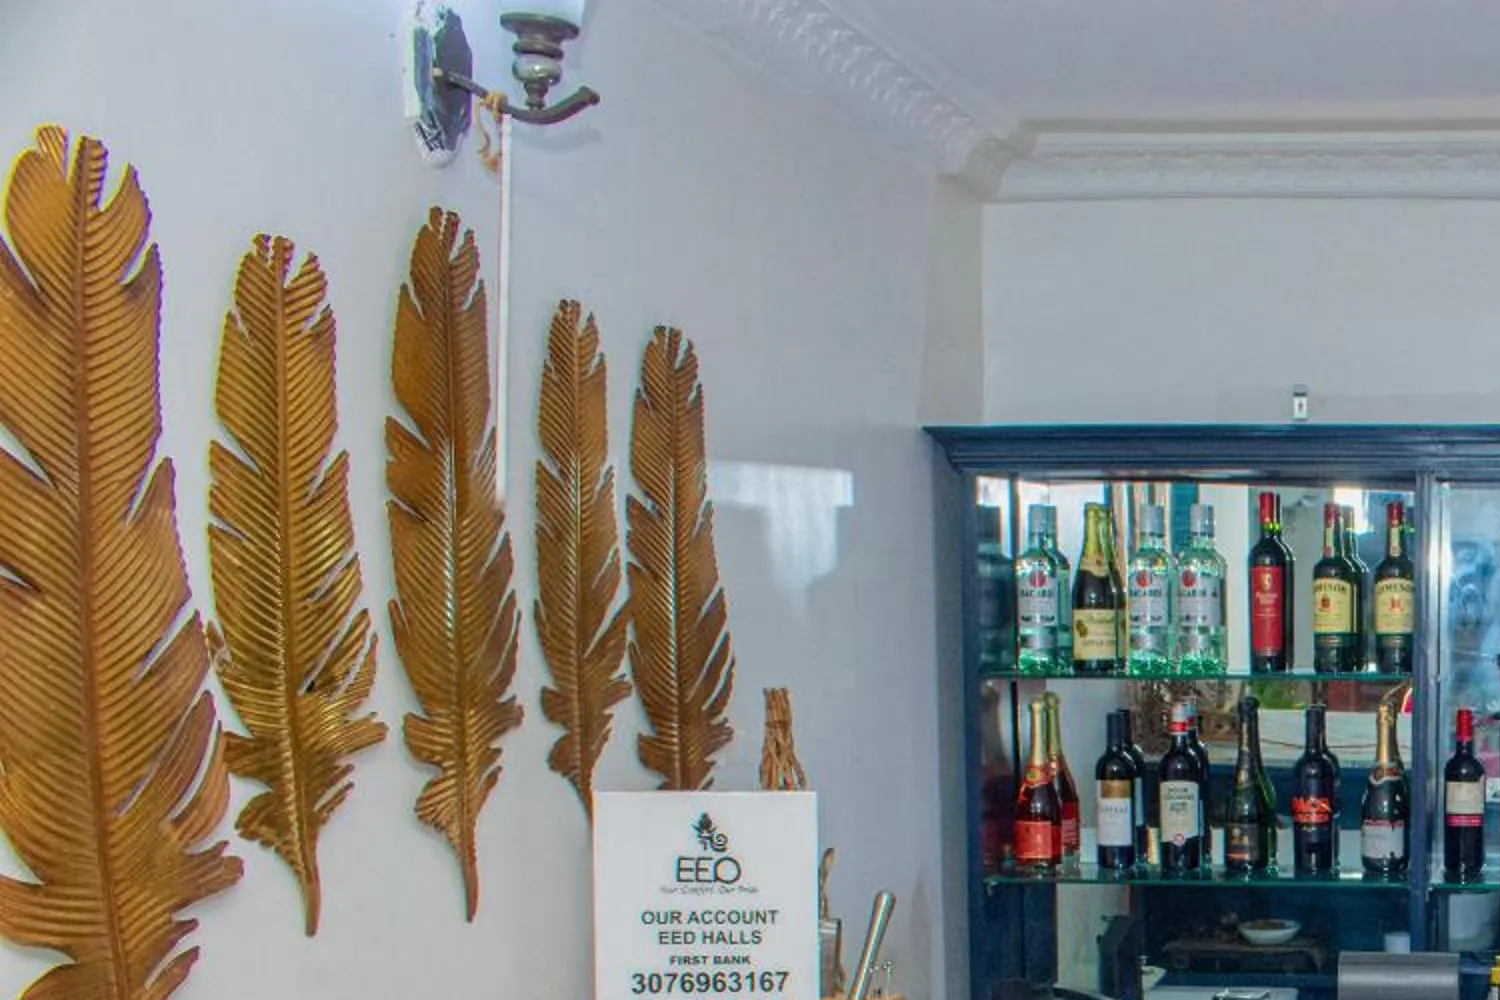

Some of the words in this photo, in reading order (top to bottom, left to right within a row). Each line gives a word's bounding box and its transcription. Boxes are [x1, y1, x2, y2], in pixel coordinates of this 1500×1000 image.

[640, 909, 683, 926] OUR
[686, 908, 780, 925] ACCOUNT
[658, 930, 696, 945] EED
[701, 929, 763, 945] HALLS
[669, 954, 709, 965] FIRST
[713, 954, 751, 965] BANK
[631, 971, 790, 995] 3076963167
